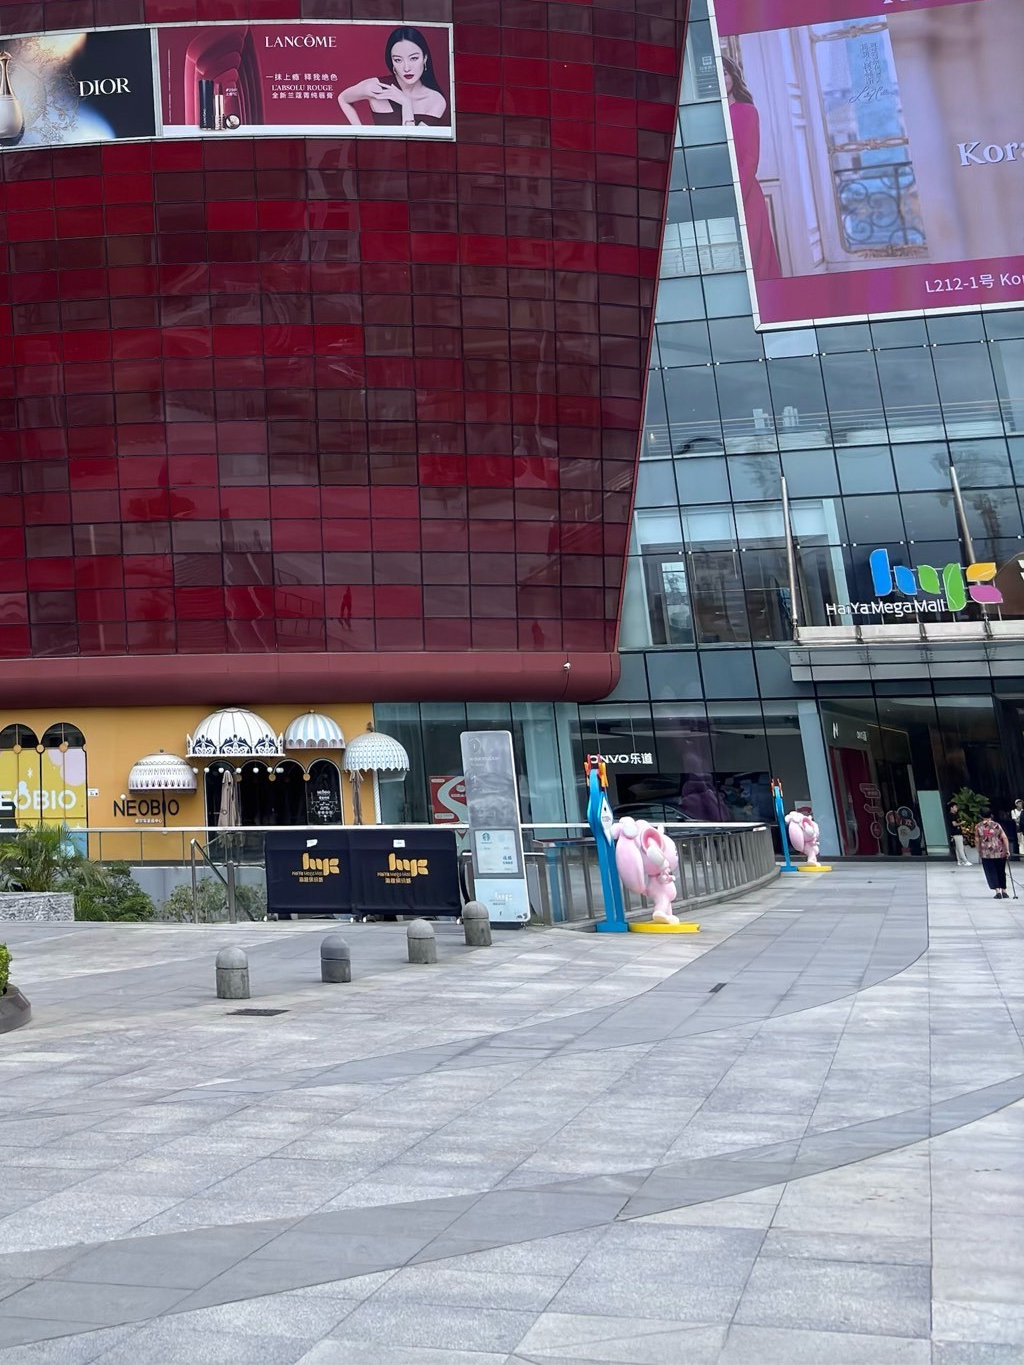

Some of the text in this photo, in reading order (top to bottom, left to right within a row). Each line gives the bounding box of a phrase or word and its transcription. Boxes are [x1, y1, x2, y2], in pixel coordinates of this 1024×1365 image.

[265, 34, 337, 48] LANCÔME
[78, 77, 131, 97] DIOR
[957, 141, 1024, 166] Kor
[925, 273, 1024, 293] L212-1号 Ko
[826, 598, 945, 618] HaiYa Mega Mall
[113, 799, 180, 817] NEOBIO
